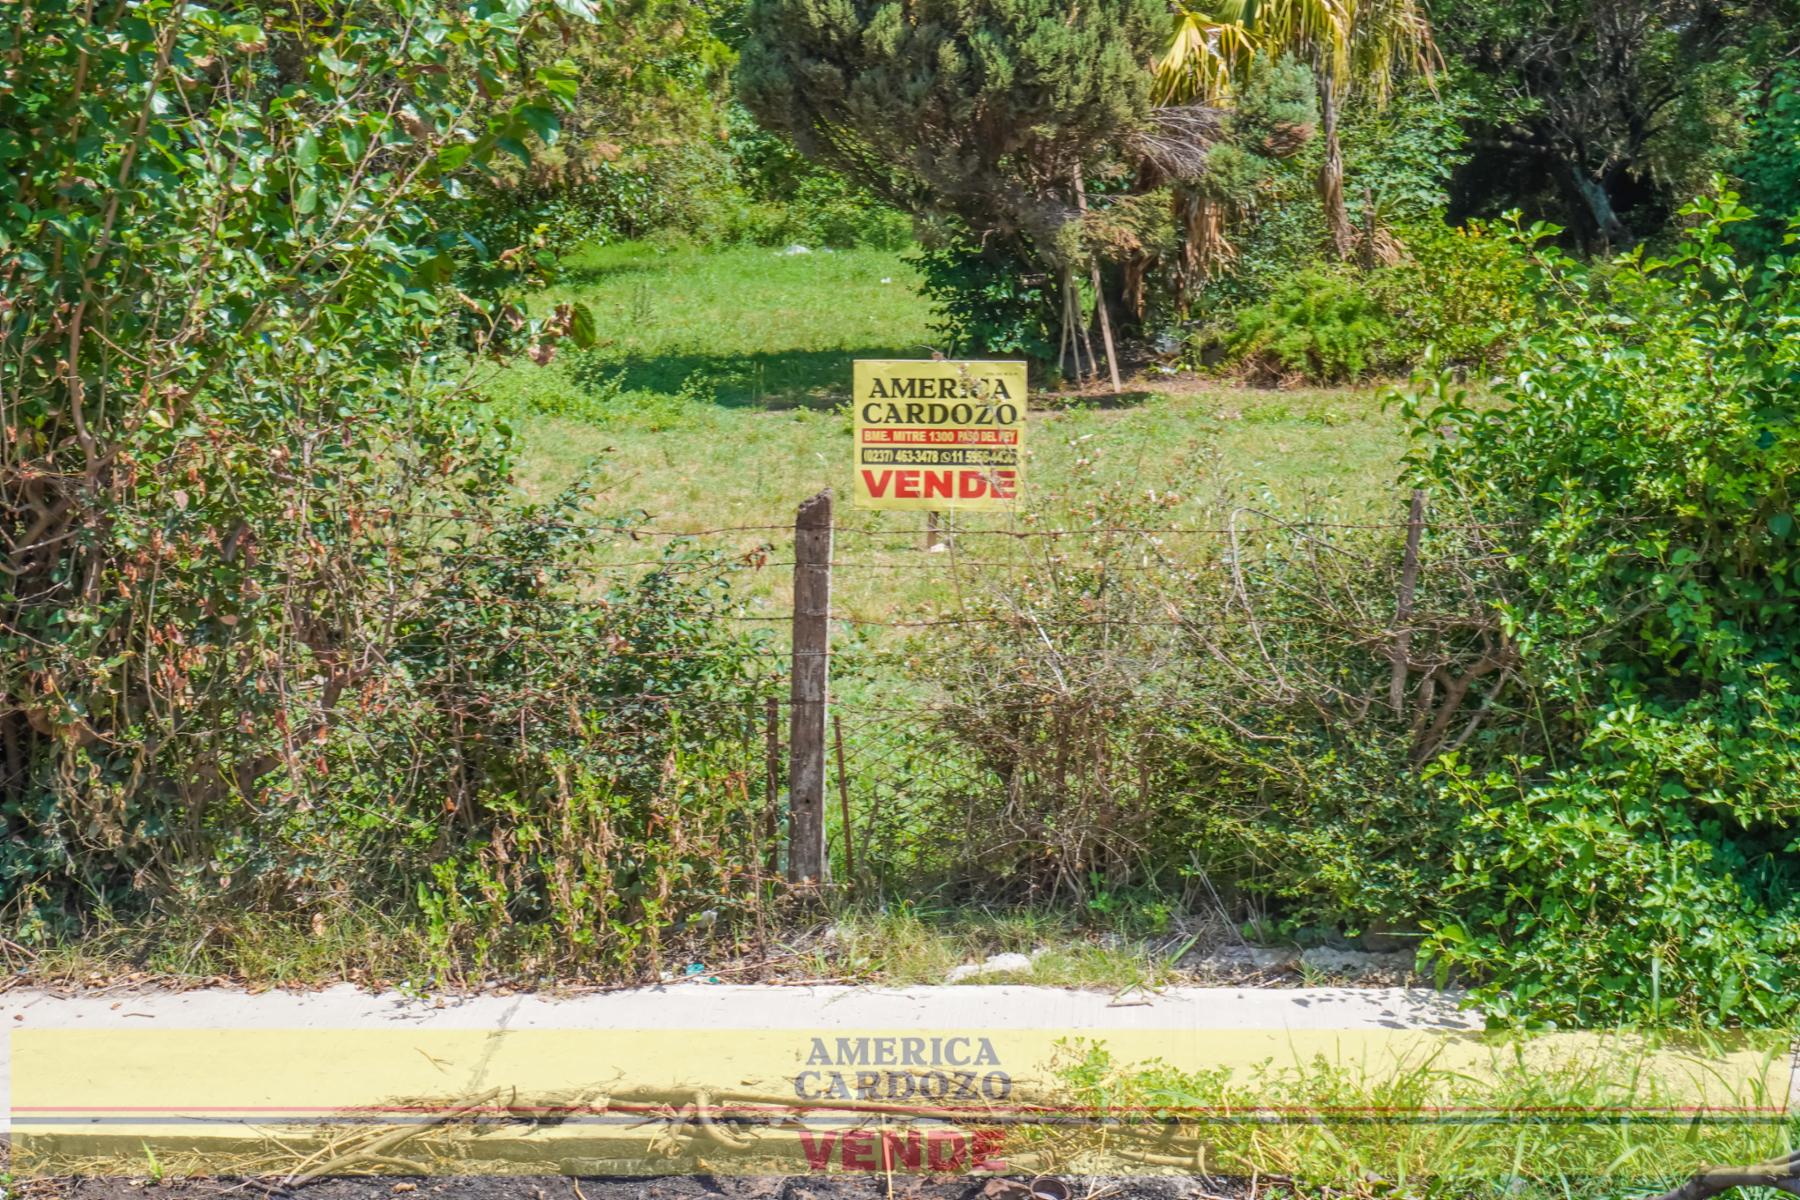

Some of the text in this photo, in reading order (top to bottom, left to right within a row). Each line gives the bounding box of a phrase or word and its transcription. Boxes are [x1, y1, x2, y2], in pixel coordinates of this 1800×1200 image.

[862, 403, 1018, 425] CARDOZO
[864, 431, 891, 442] BME.
[893, 431, 927, 442] MITRE
[930, 431, 954, 442] 1300
[957, 431, 979, 442] PASO
[981, 431, 997, 442] DEL
[863, 450, 894, 463] (0237)
[895, 450, 939, 463] 463-3478
[861, 470, 1017, 499] VENDE
